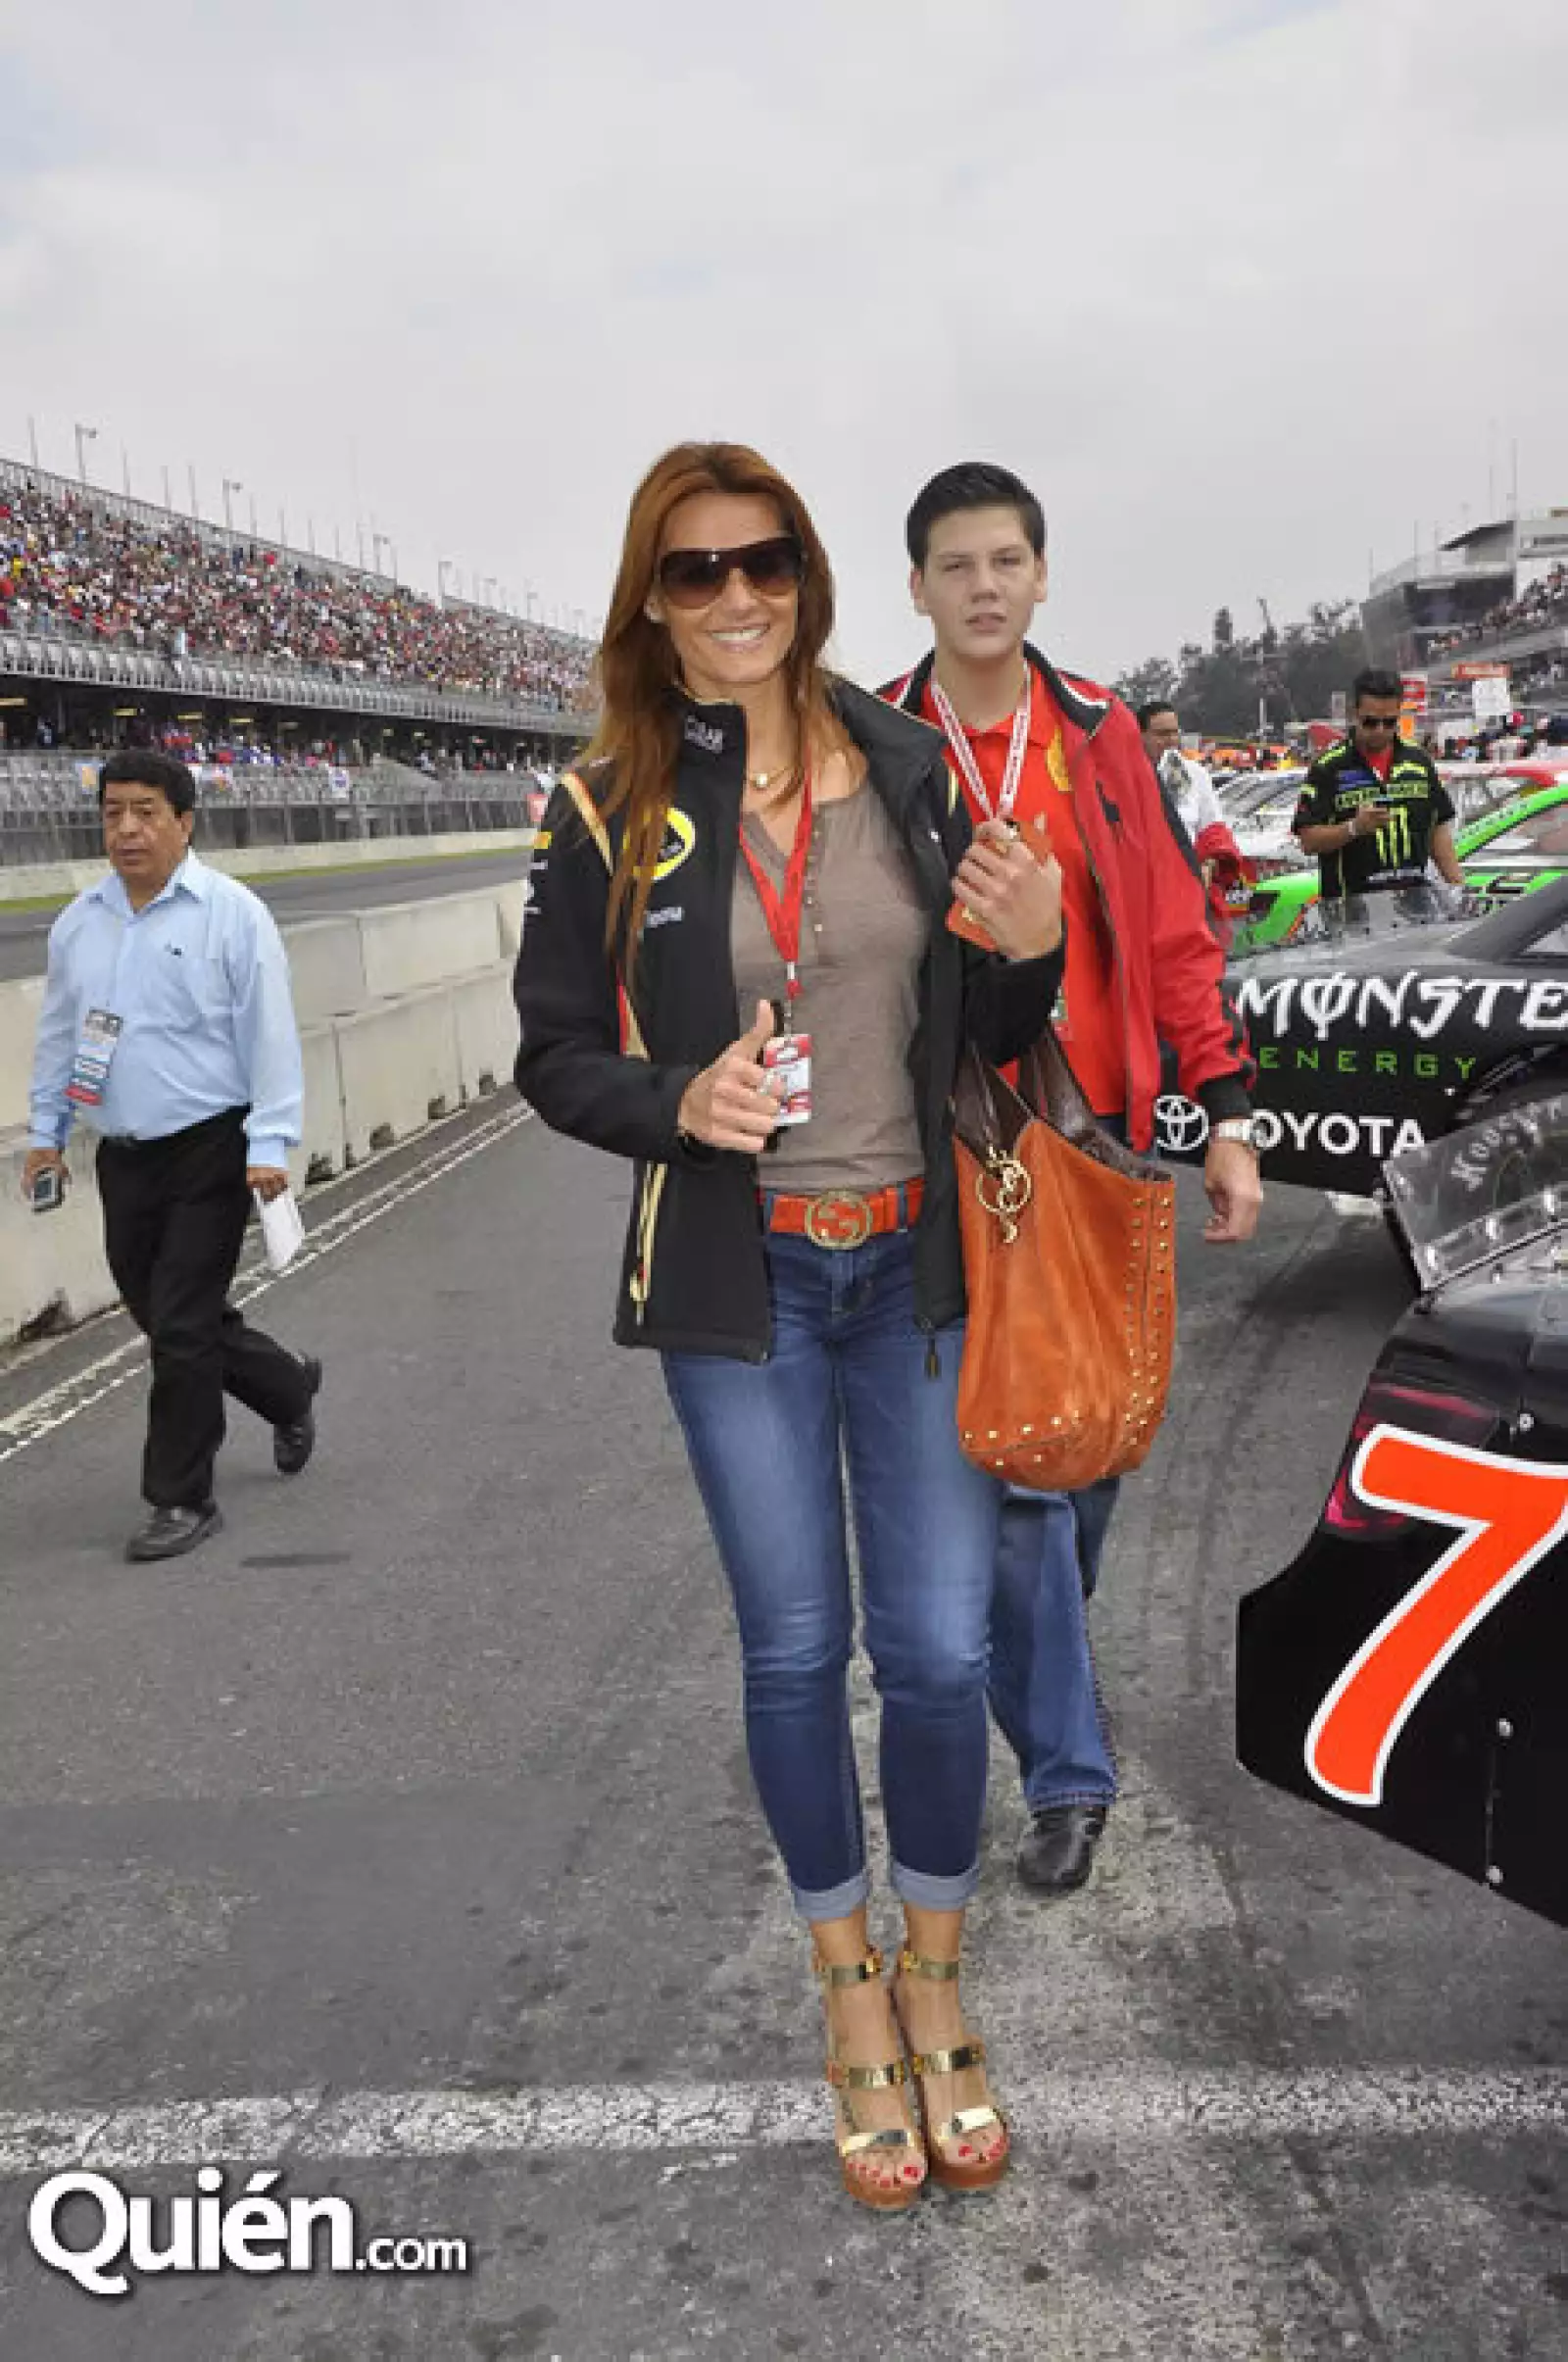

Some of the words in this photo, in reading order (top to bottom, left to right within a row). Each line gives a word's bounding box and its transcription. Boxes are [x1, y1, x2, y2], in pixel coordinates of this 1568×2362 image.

[1259, 1047, 1477, 1079] ENERGY
[1250, 1107, 1426, 1157] OYOTA
[1304, 1423, 1568, 1806] 7
